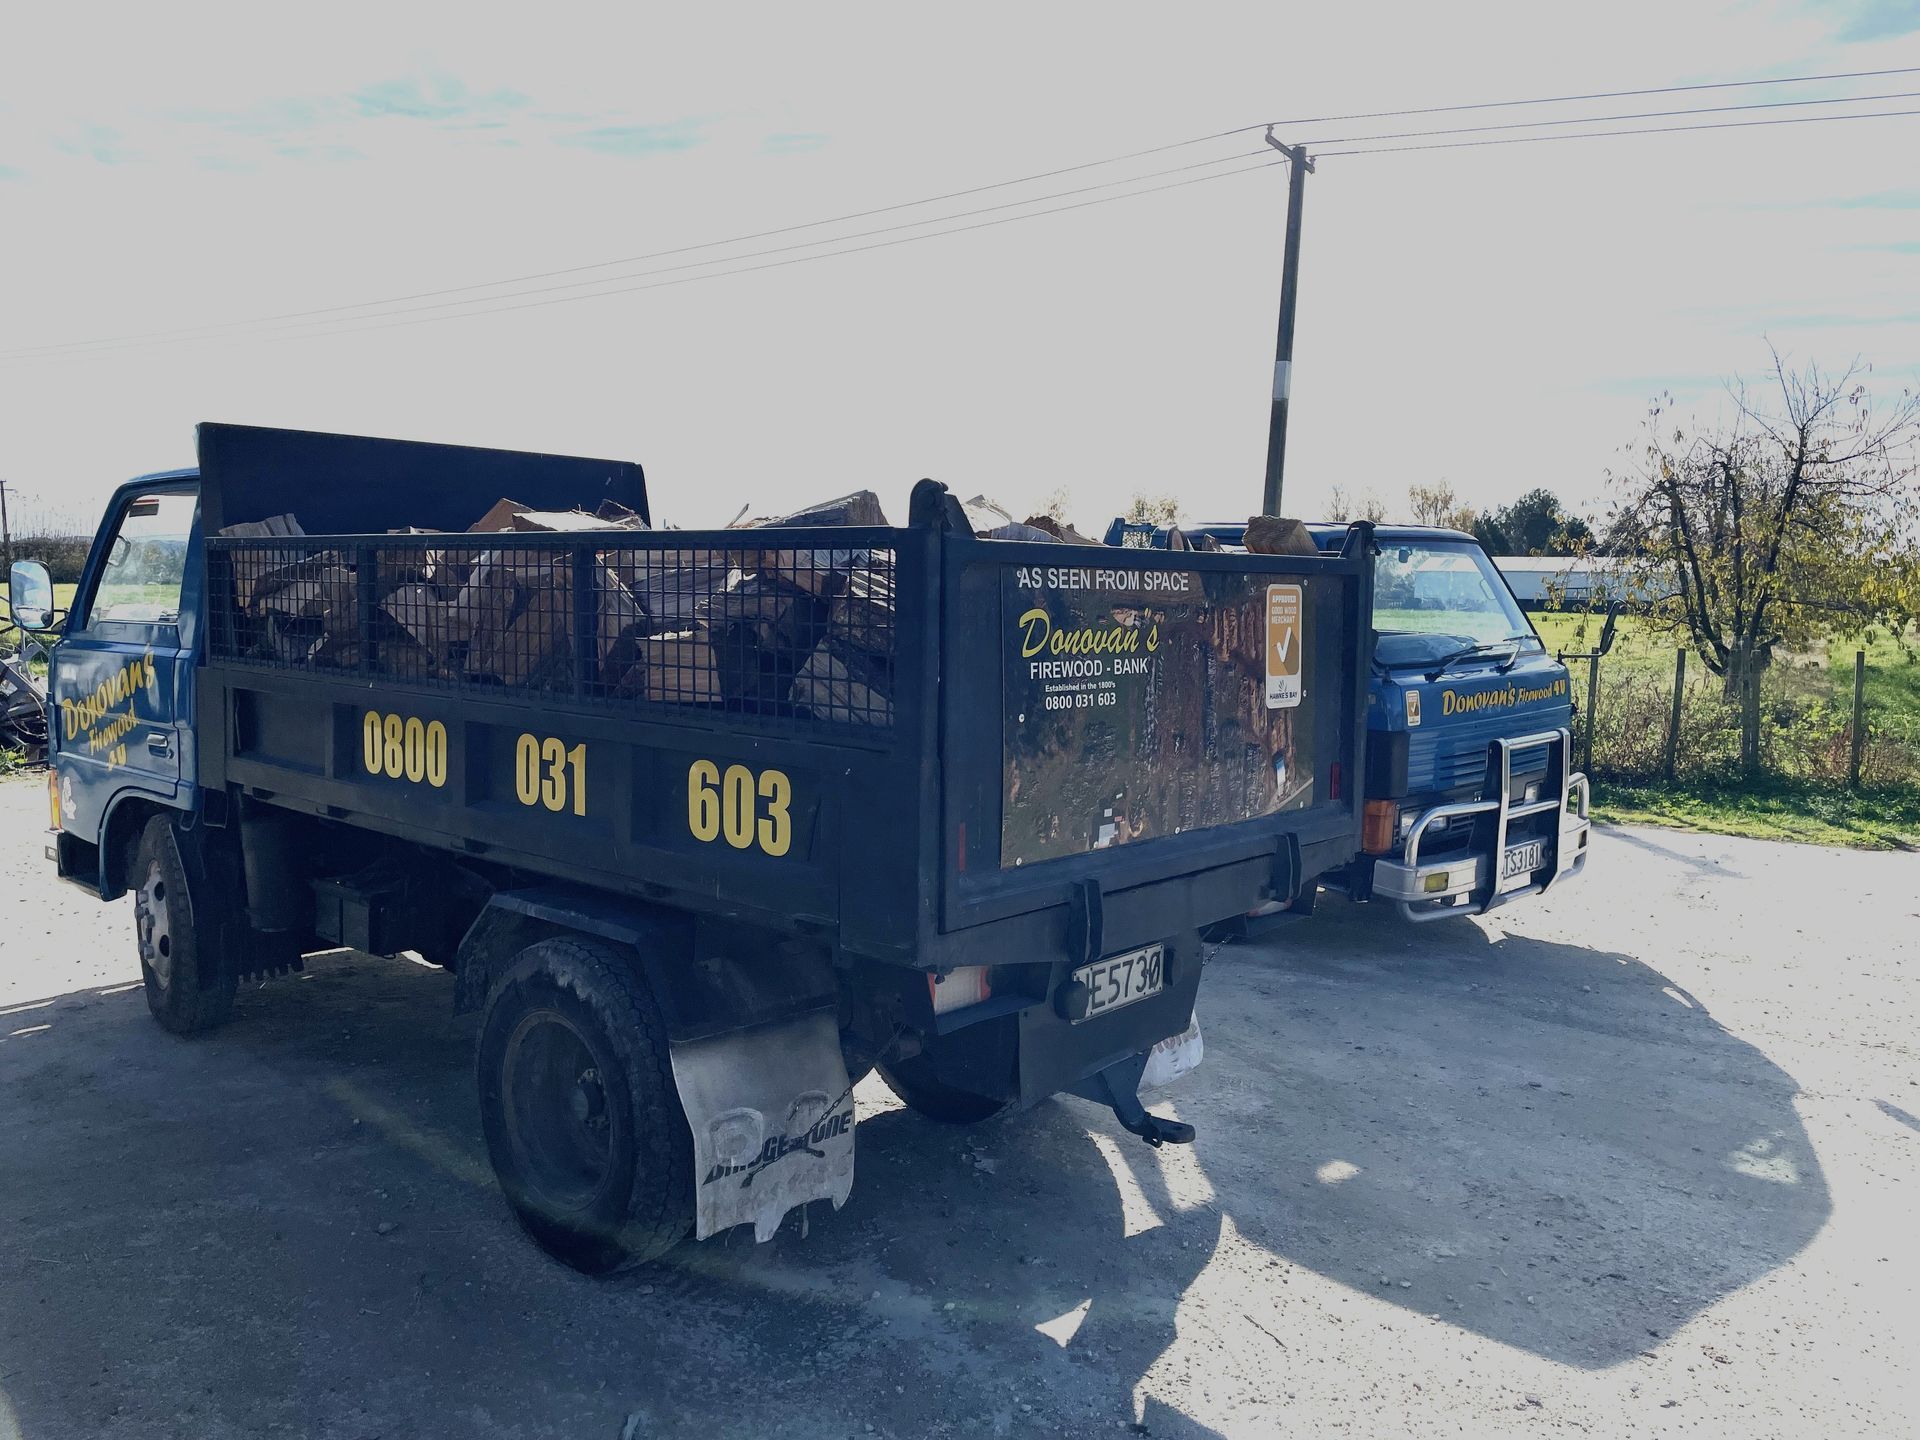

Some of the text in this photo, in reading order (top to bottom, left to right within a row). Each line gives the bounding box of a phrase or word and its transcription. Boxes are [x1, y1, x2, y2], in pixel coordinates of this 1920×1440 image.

[1018, 567, 1189, 592] AS SEEN FROM SPACE
[1018, 608, 1160, 659] Donovan's
[1030, 660, 1103, 680] FIREWOOD
[1114, 658, 1149, 676] BANK
[1045, 682, 1080, 693] Established
[1080, 682, 1087, 690] in
[1087, 682, 1097, 690] the
[1045, 692, 1117, 711] 0800 031 603
[1442, 681, 1516, 716] Donovan's
[1517, 683, 1553, 702] Firewood
[88, 697, 140, 756] Firewood
[363, 710, 792, 857] 0800 031 603
[1083, 951, 1161, 1010] E5730
